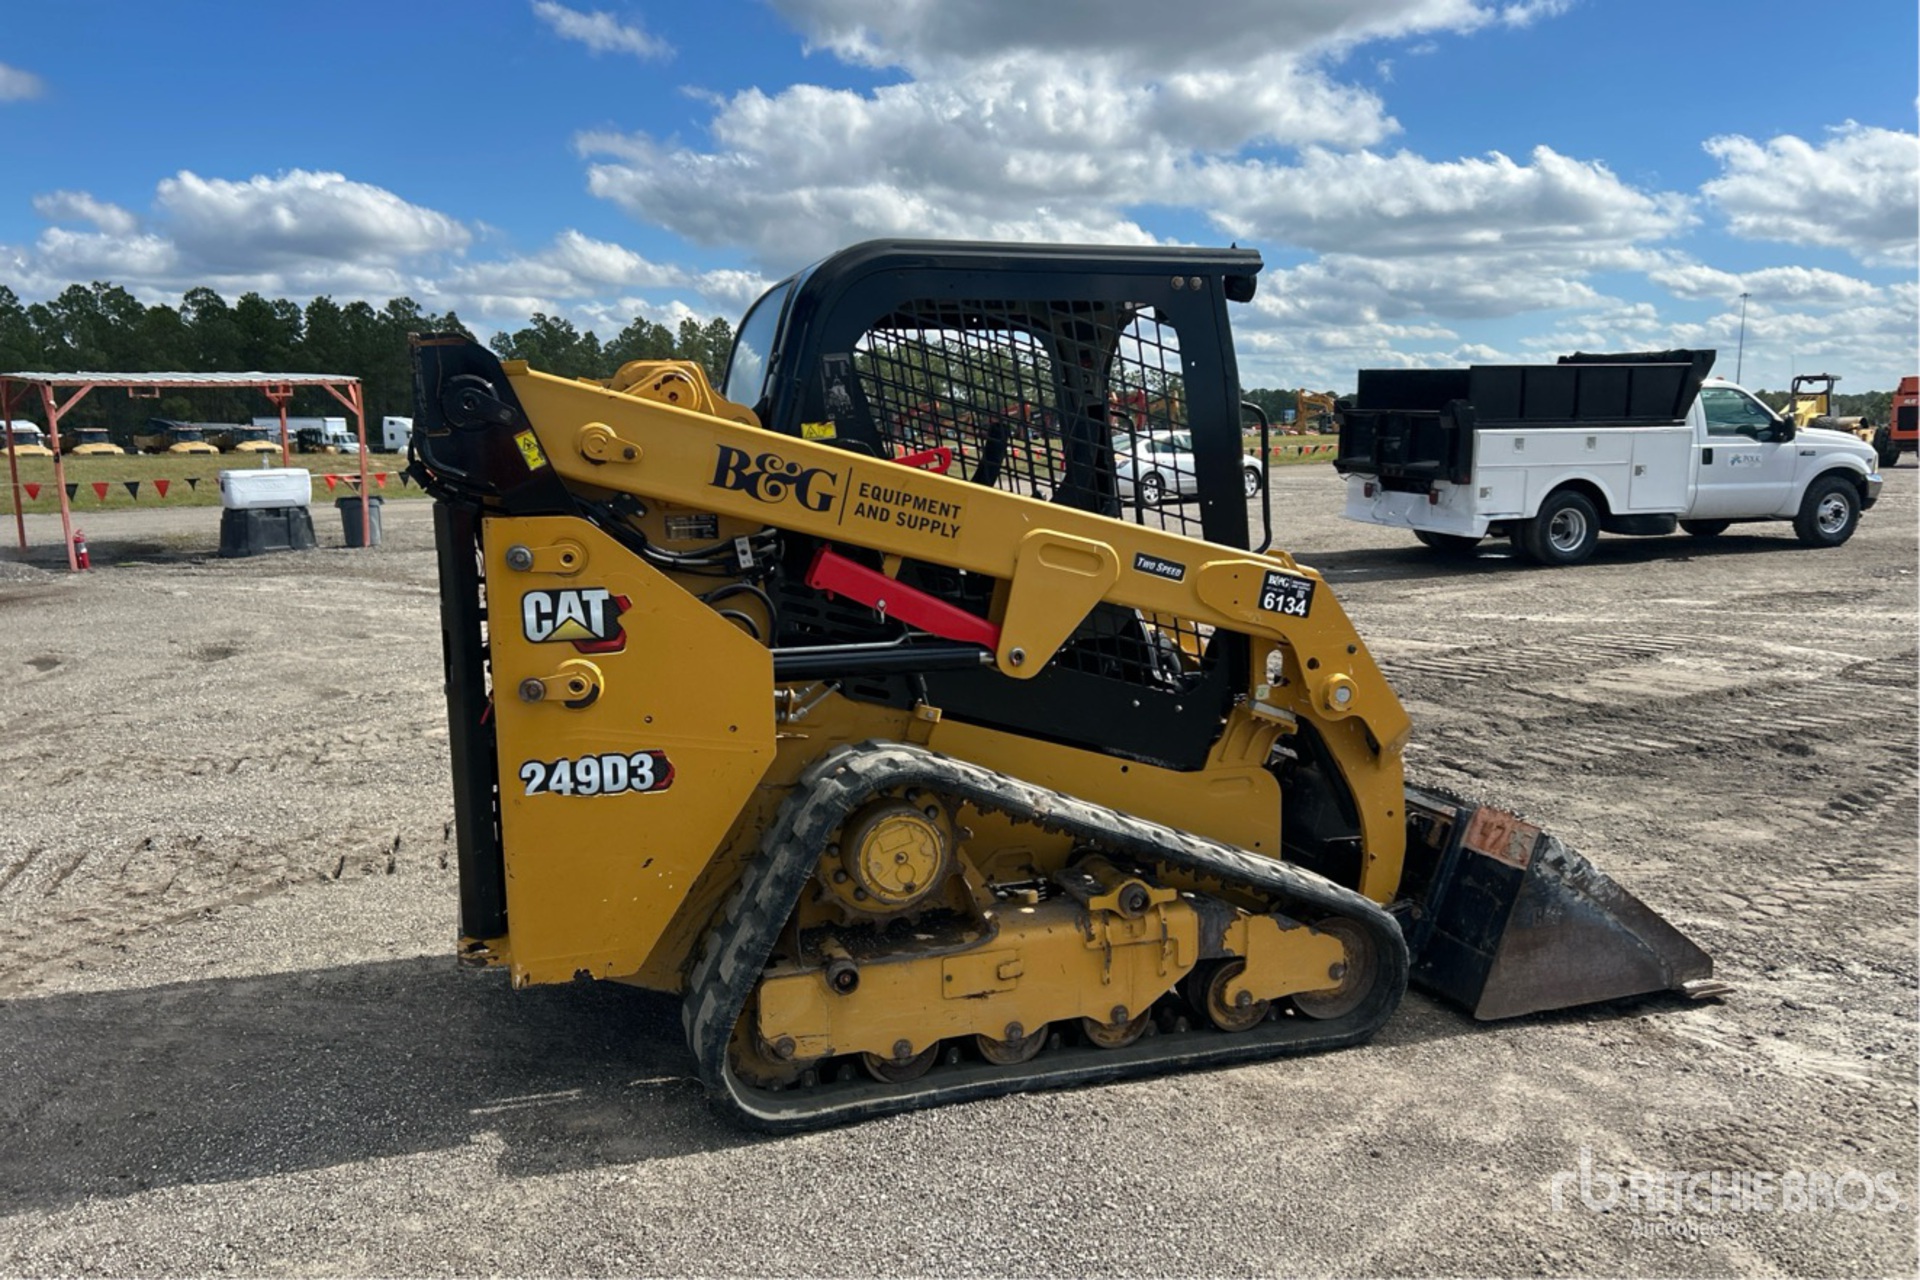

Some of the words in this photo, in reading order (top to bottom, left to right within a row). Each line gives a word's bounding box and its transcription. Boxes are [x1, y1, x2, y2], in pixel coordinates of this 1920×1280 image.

[708, 444, 838, 512] B&G
[854, 502, 890, 522] AND
[896, 511, 961, 539] SUPPLY
[858, 482, 961, 519] EQUIPMENT
[523, 589, 609, 642] CAT
[1263, 592, 1307, 616] 6134
[520, 752, 655, 796] 249D3
